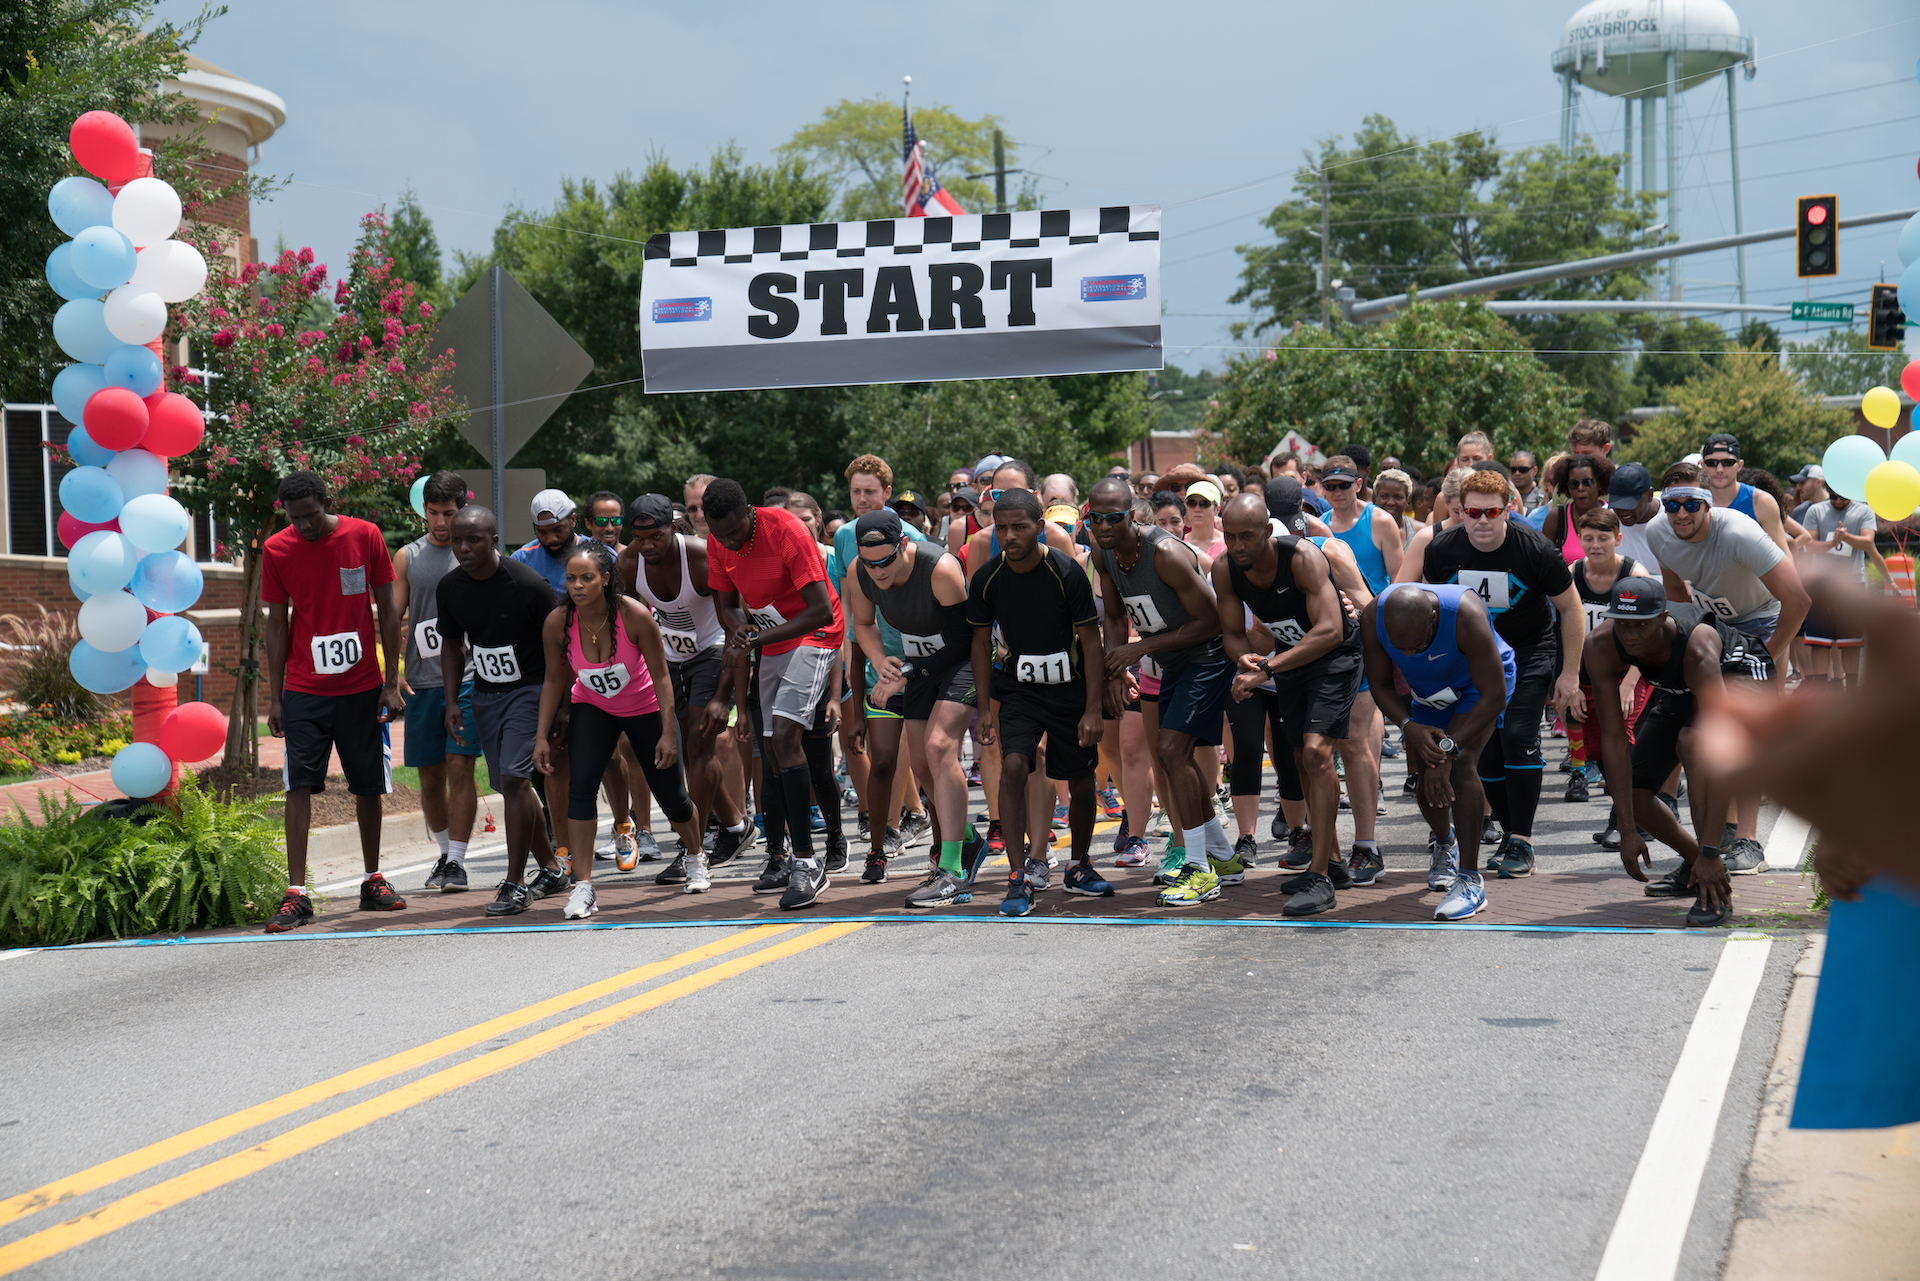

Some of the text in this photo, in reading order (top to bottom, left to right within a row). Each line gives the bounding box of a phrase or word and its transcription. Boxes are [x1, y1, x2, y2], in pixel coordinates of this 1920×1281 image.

[748, 257, 1053, 339] START
[1803, 305, 1853, 319] E Atlanta Rd
[1477, 577, 1492, 602] 4
[1126, 602, 1152, 627] 81
[1617, 604, 1638, 612] adidas
[663, 633, 698, 654] 129
[1271, 625, 1306, 643] 33
[317, 638, 359, 667] 130
[477, 652, 516, 677] 135
[589, 671, 621, 694] 95
[1021, 659, 1065, 683] 311
